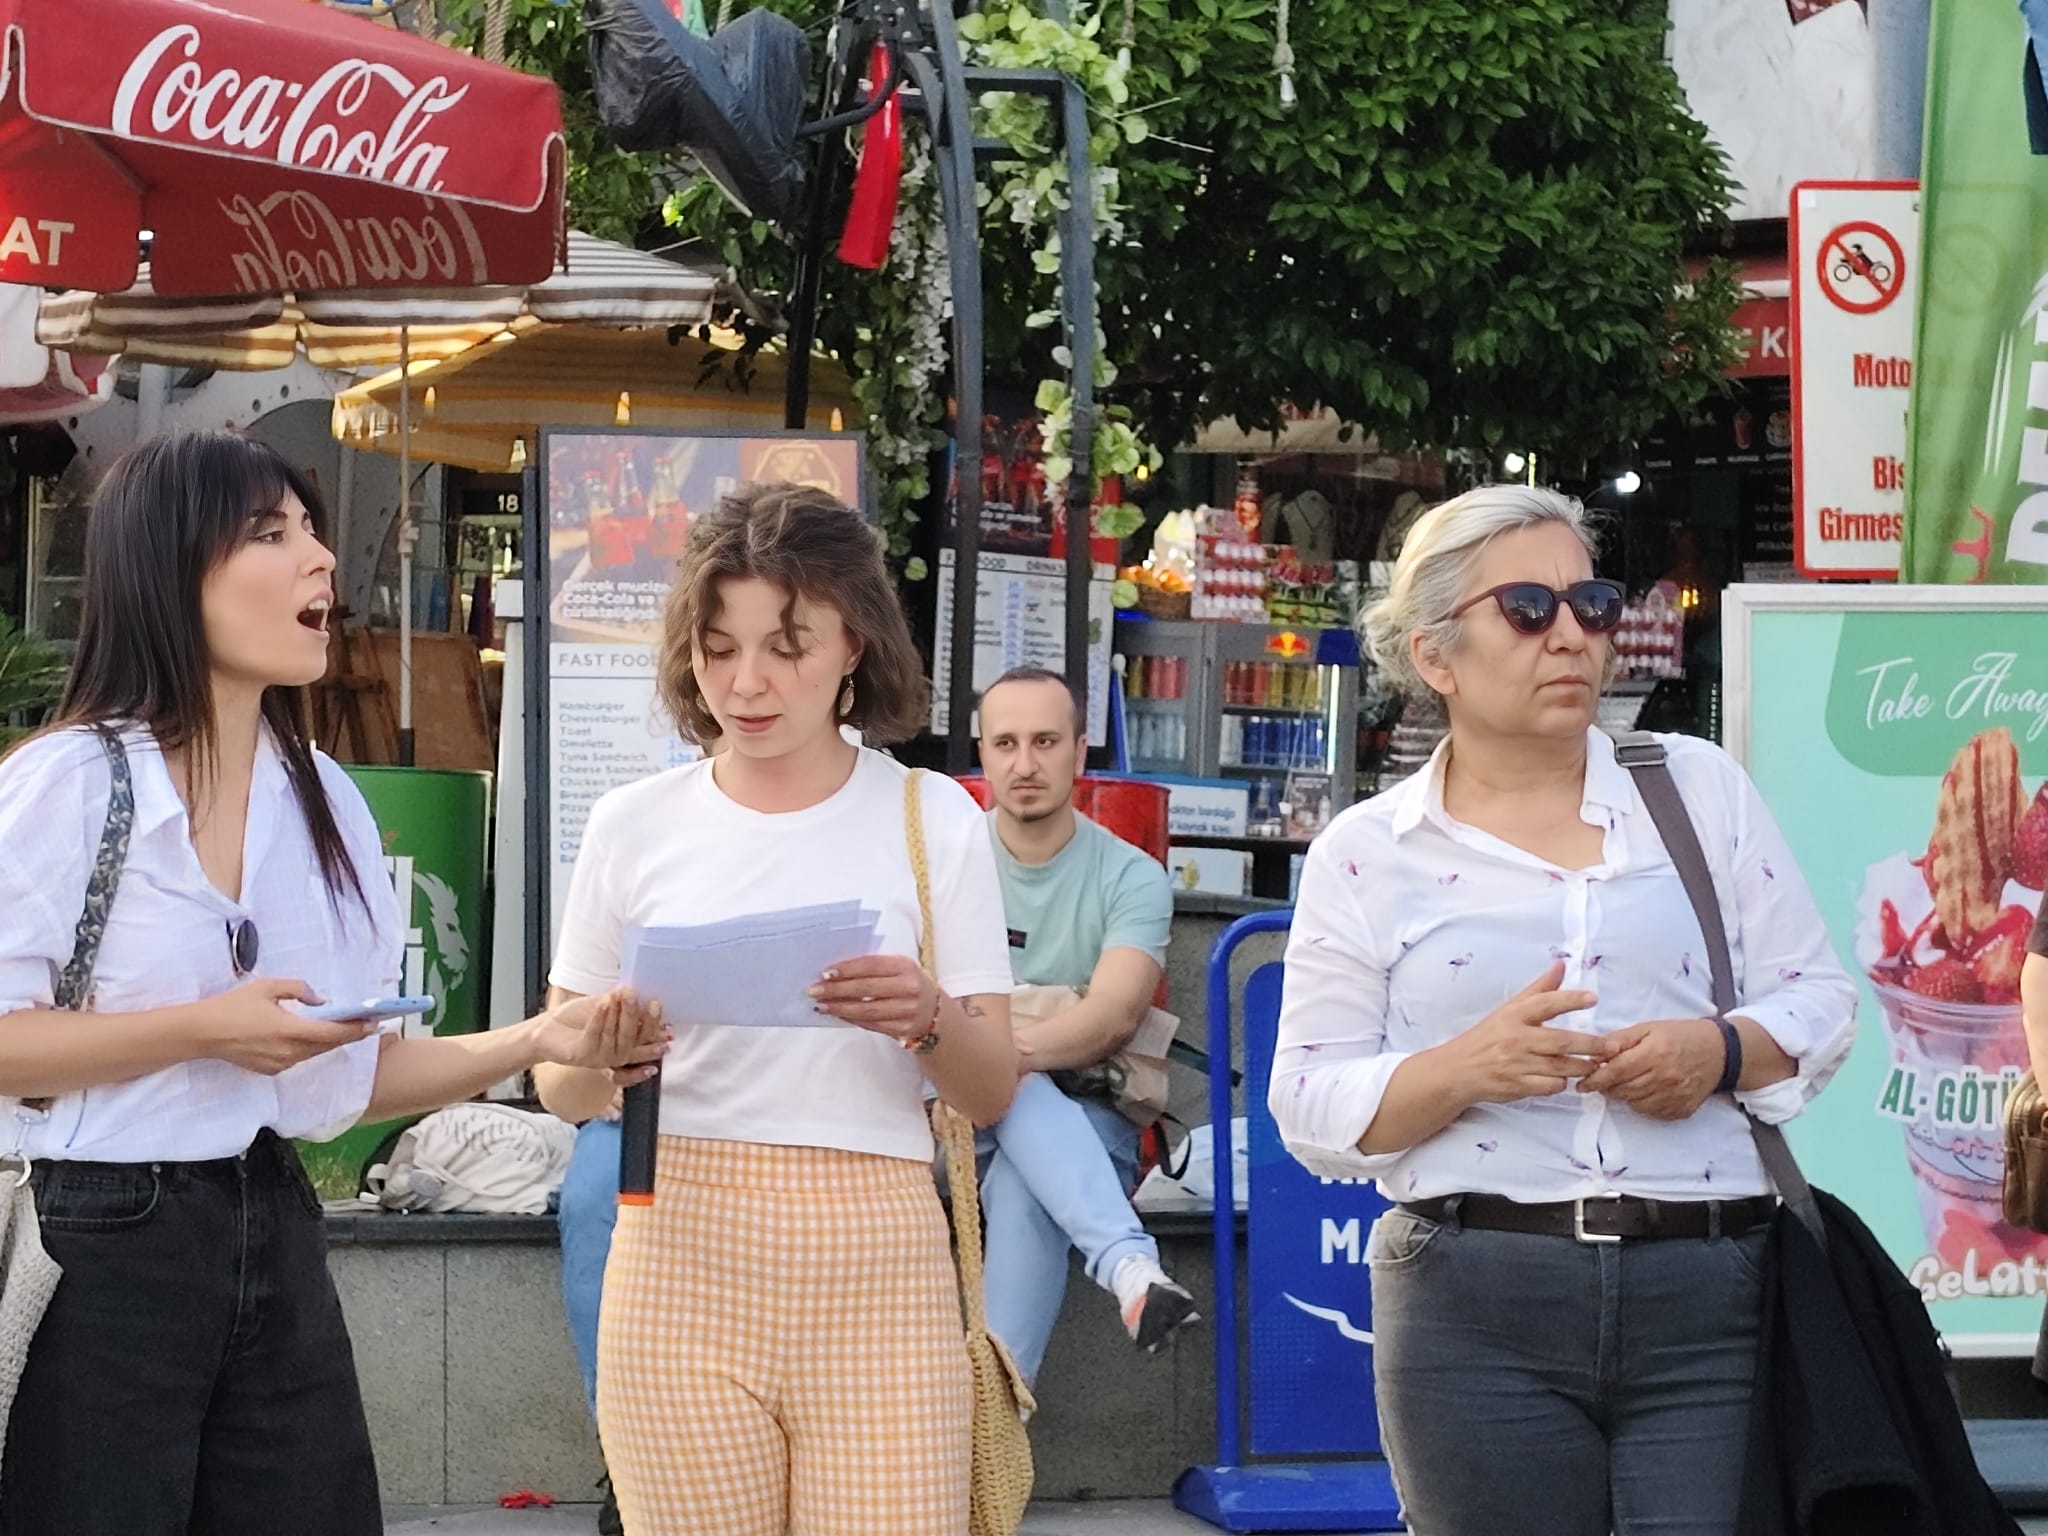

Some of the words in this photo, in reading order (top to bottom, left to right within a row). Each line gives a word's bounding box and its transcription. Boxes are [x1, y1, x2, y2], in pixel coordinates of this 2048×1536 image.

[112, 24, 470, 194] Coca-Cola
[498, 494, 519, 513] 18
[559, 653, 605, 667] FAST
[1856, 656, 1935, 730] Take
